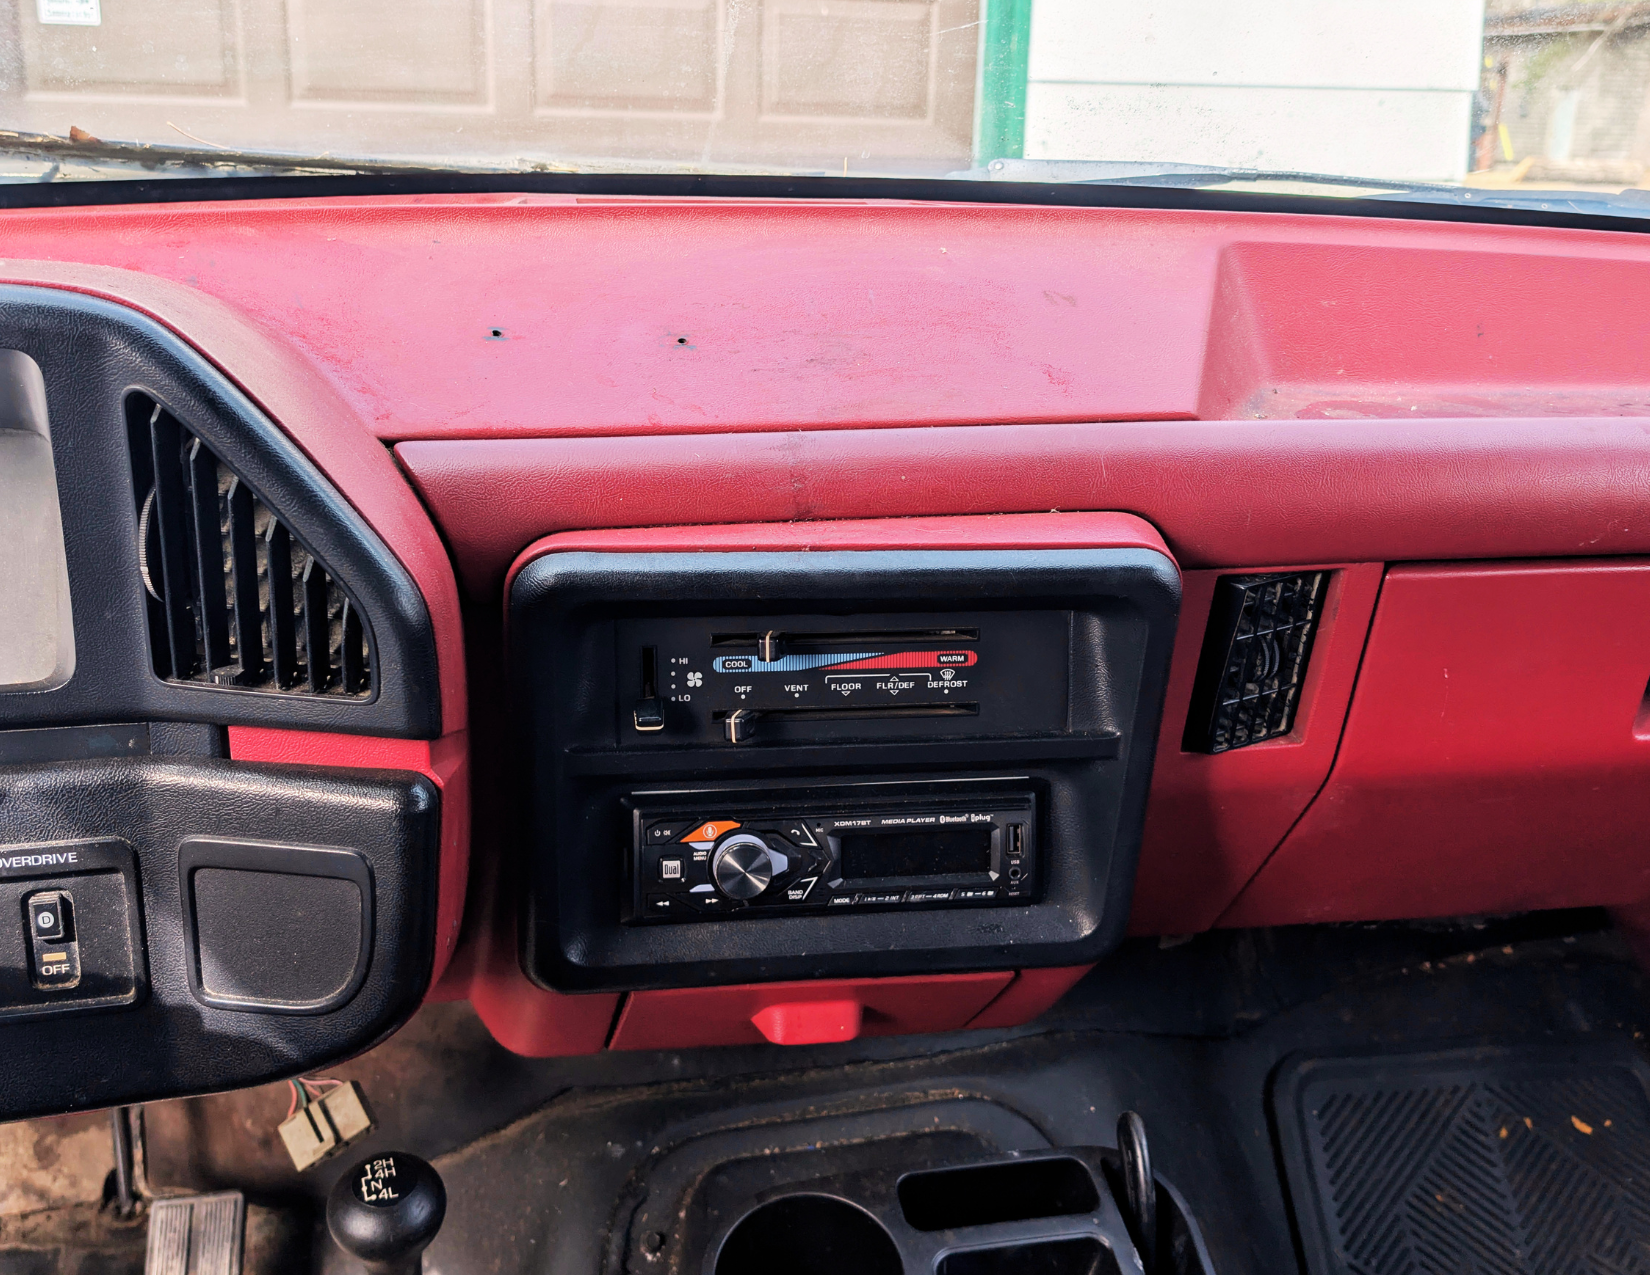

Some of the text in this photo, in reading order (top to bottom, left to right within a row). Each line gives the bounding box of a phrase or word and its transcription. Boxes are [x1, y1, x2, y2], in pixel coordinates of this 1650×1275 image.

[725, 660, 748, 668] COOL
[784, 684, 809, 692] VENT
[831, 683, 862, 691] FLOOR
[876, 682, 915, 690] FLR/DEF
[927, 680, 968, 688] DEFROST
[678, 694, 691, 702] LO
[664, 863, 680, 875] Dual
[41, 915, 51, 925] D
[41, 963, 70, 976] OFF
[373, 1157, 394, 1171] 2H
[374, 1166, 397, 1179] 4H
[370, 1179, 383, 1192] N
[378, 1186, 399, 1200] 4L
